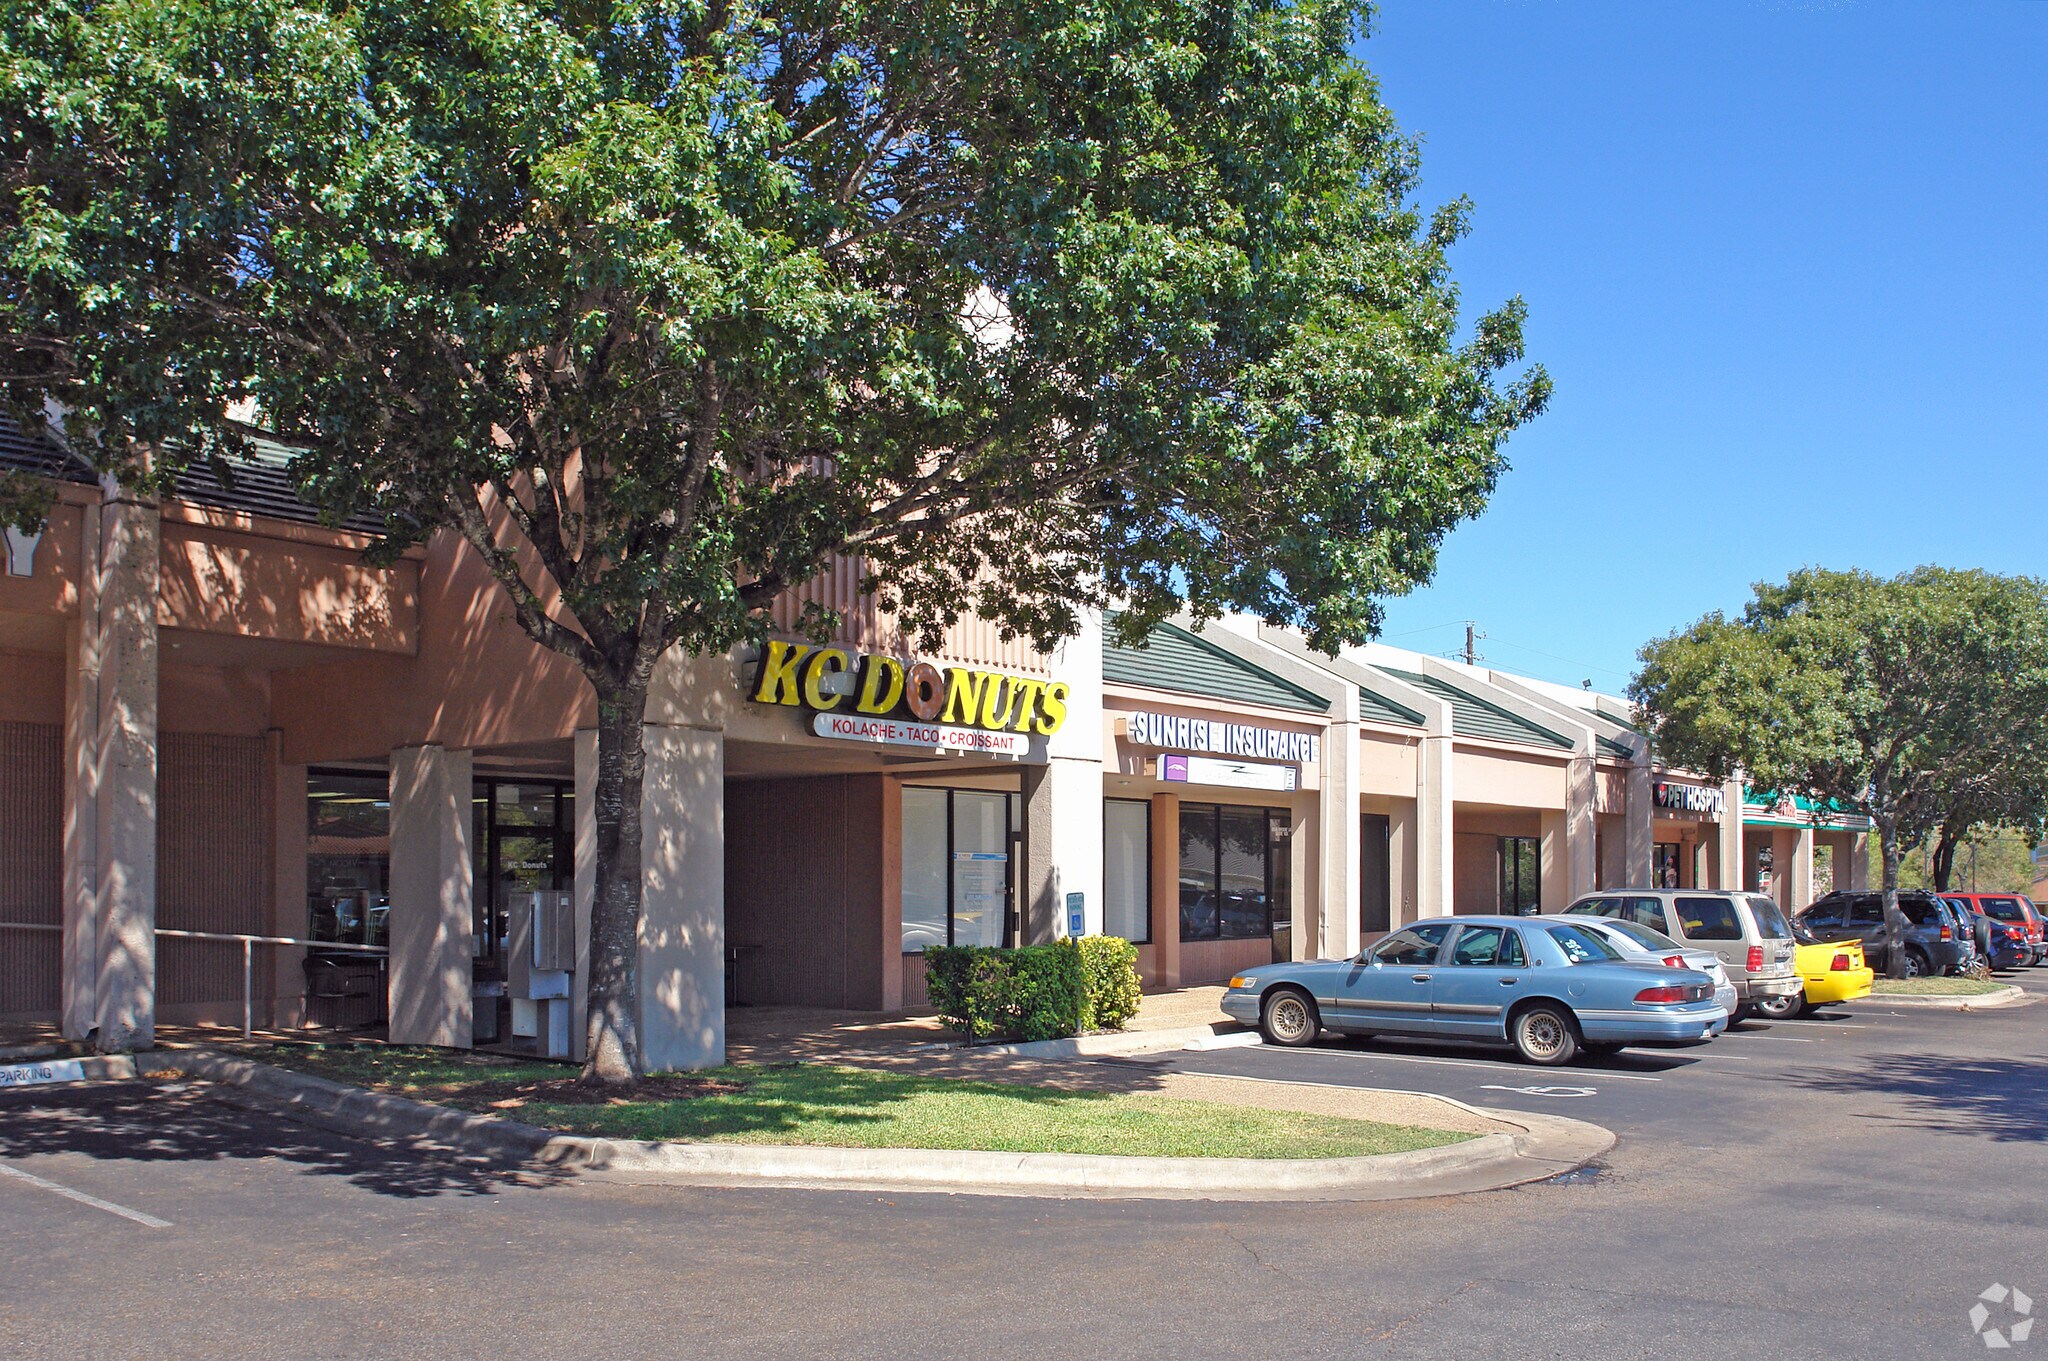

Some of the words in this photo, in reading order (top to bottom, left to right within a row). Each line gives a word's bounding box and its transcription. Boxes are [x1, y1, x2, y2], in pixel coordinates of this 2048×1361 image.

[753, 640, 848, 710] KC
[856, 655, 1070, 736] DONUTS
[832, 718, 896, 739] KOLACHE
[906, 727, 940, 743] TACO
[949, 733, 1015, 749] CROISSANT
[1134, 711, 1220, 753] SUNRISE
[1224, 723, 1320, 762] INSURANCE
[1667, 784, 1686, 808] PET
[1687, 786, 1728, 814] HOSPITAL
[507, 861, 519, 869] KC
[522, 861, 547, 869] Donuts
[0, 1067, 52, 1081] PARKING
